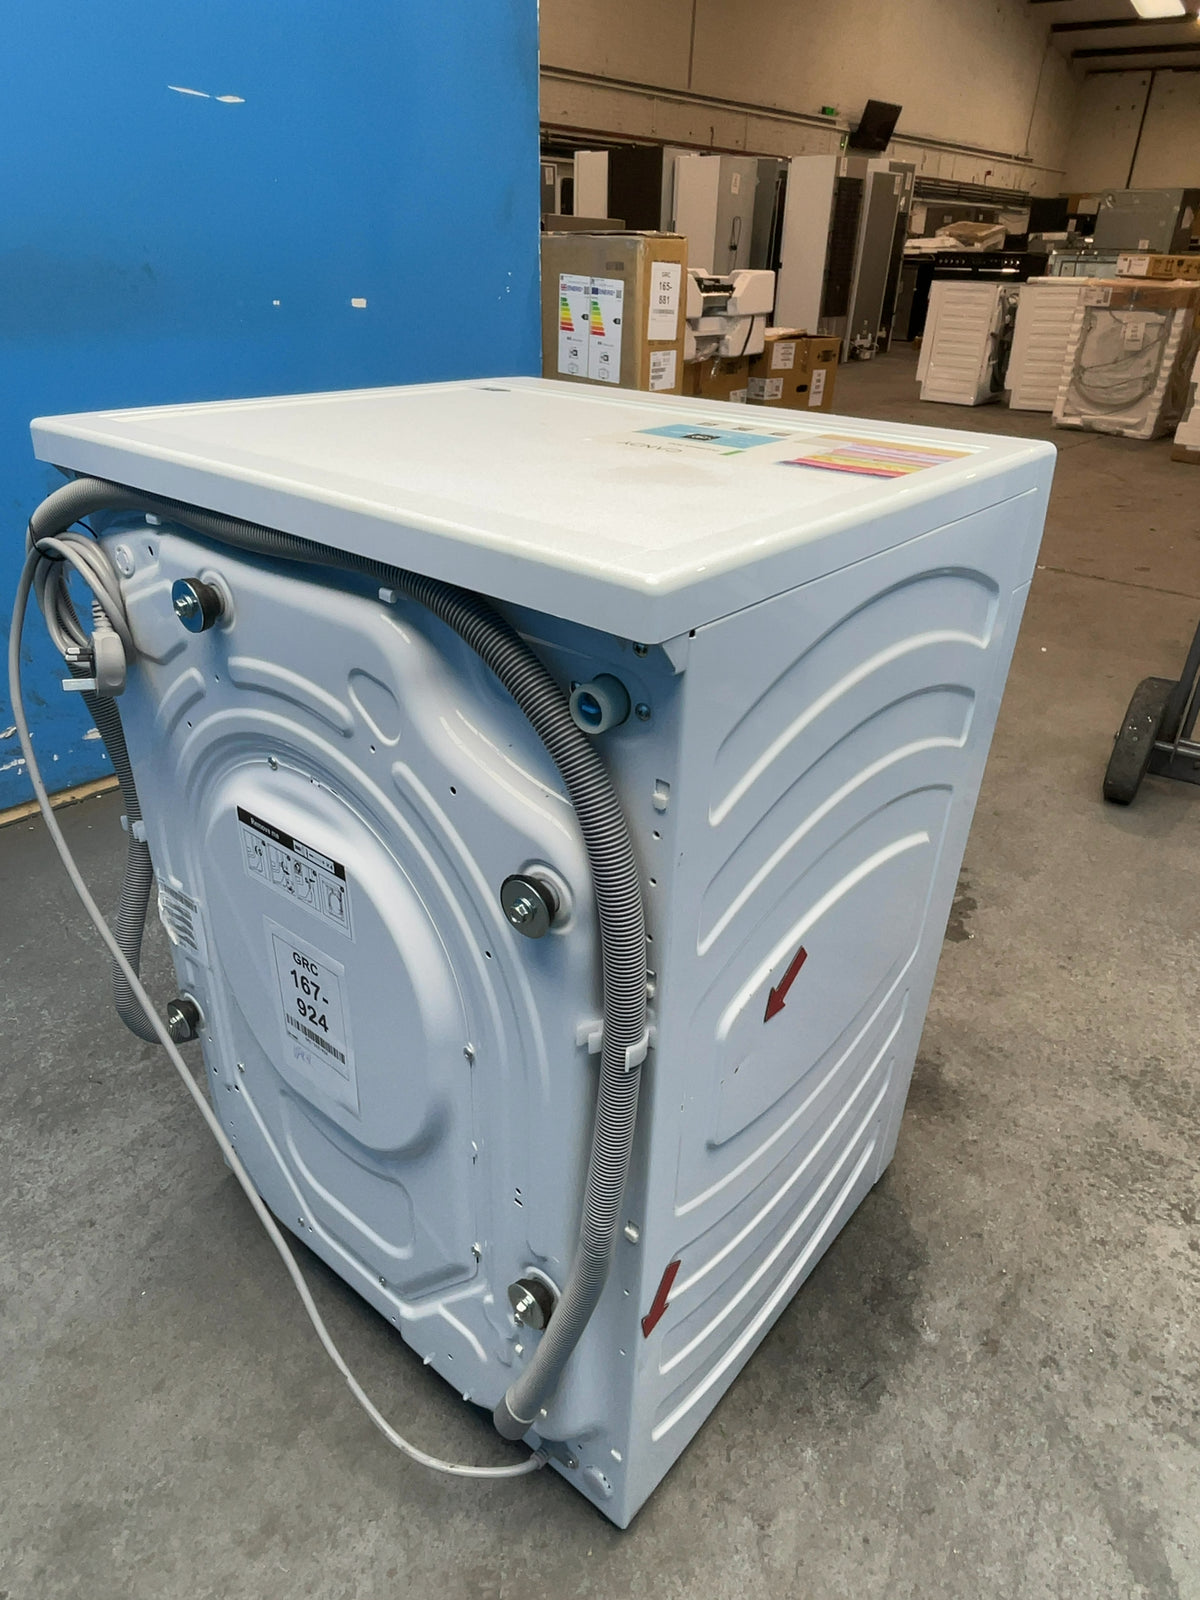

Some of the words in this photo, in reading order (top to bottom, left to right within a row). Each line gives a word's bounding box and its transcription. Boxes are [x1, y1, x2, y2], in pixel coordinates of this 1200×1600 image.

[659, 281, 672, 291] 165-
[292, 951, 319, 977] GRC
[290, 969, 329, 1005] 167-
[296, 997, 329, 1033] 924
